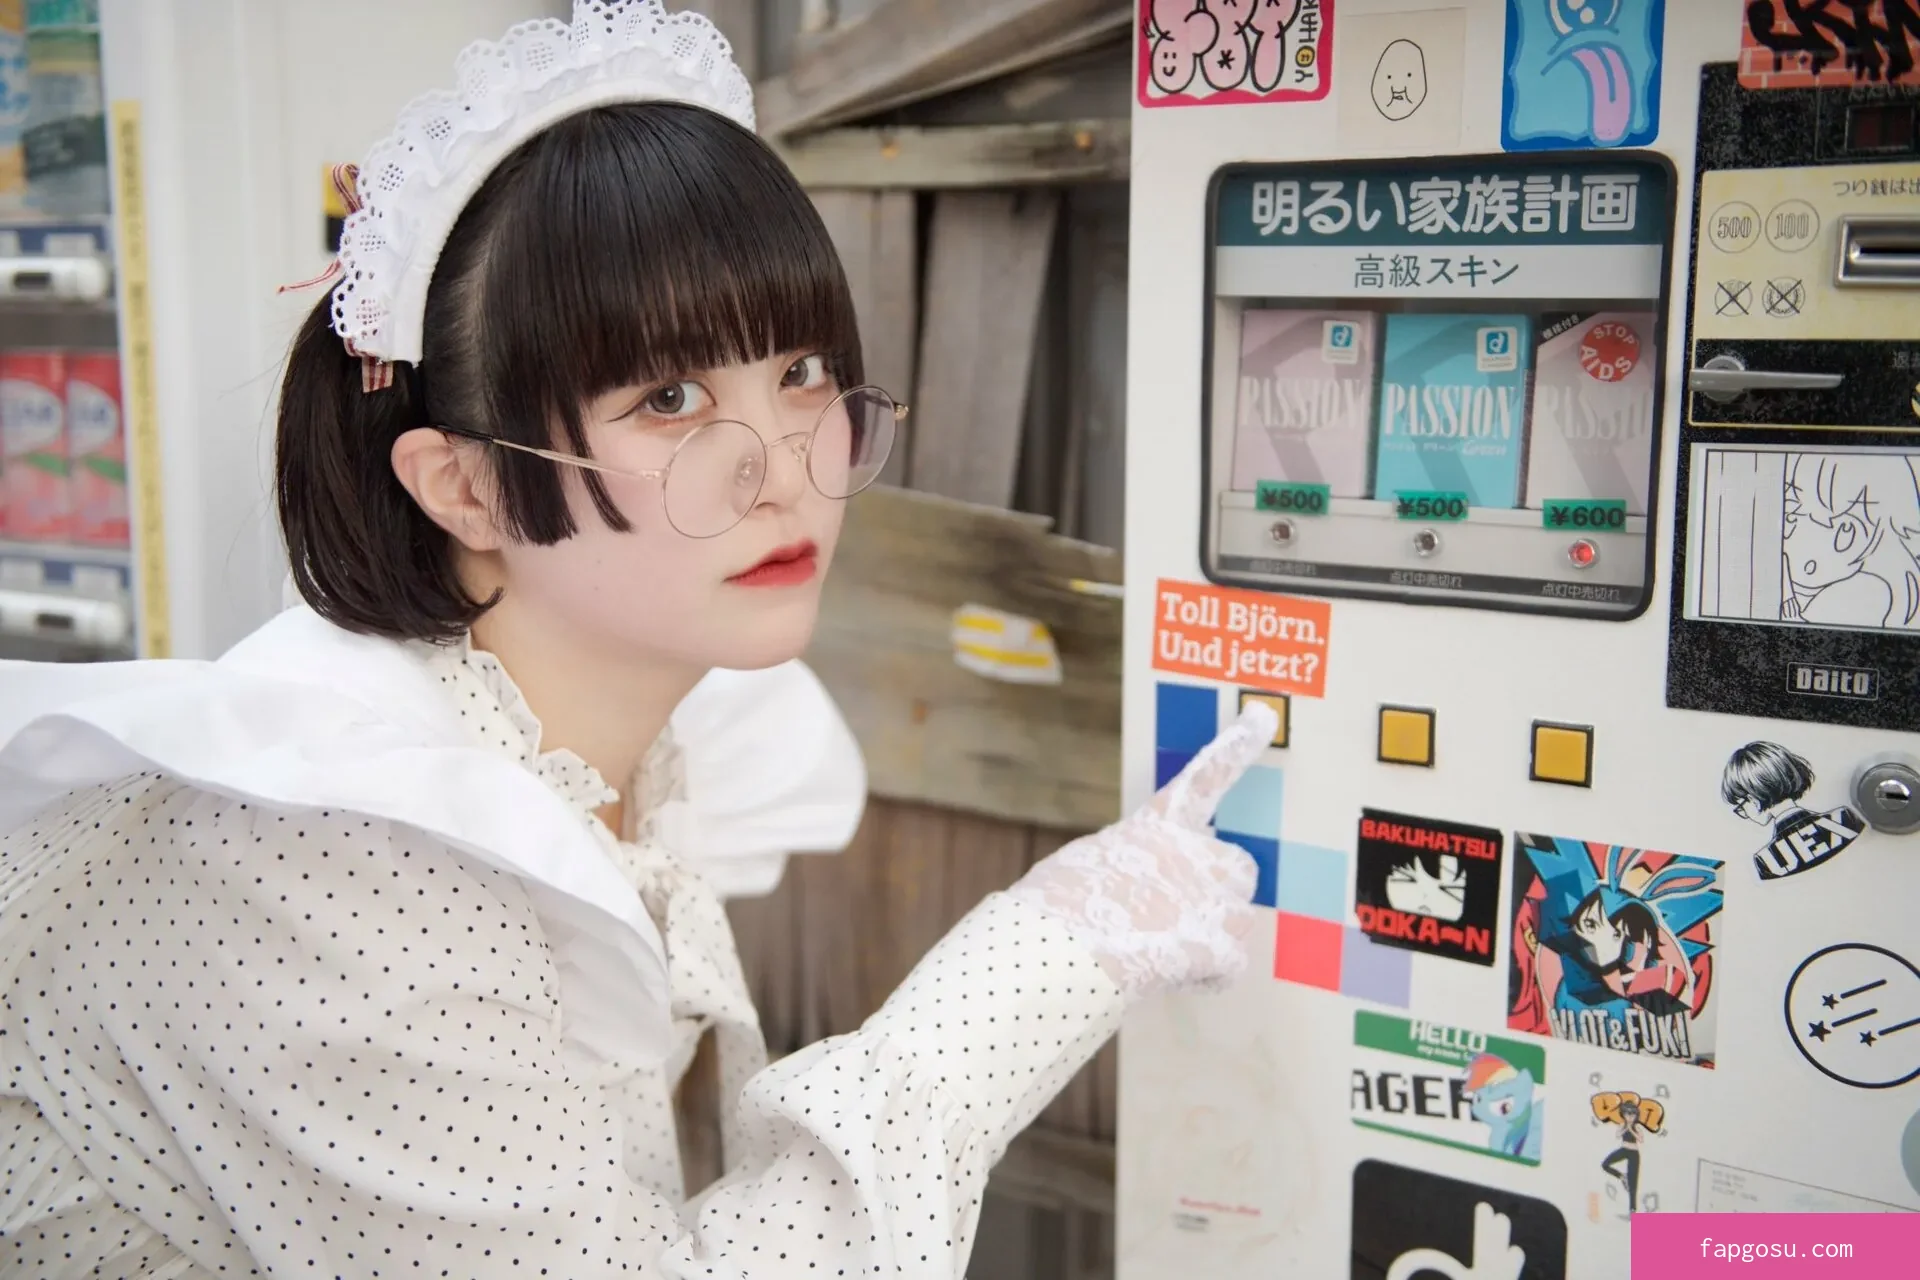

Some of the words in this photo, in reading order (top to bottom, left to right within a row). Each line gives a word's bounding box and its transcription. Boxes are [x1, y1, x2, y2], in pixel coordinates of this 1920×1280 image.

[1252, 174, 1640, 236] 明るい家族計画
[1717, 215, 1752, 239] 500
[1773, 212, 1810, 240] 100
[1353, 253, 1519, 288] 高級スキン
[1593, 323, 1635, 345] STOP
[1582, 345, 1632, 380] AIDS
[1240, 375, 1365, 429] PASSION
[1384, 382, 1518, 440] PASSION
[1538, 383, 1655, 442] PASSIO
[1262, 487, 1323, 512] ¥500
[1396, 496, 1464, 518] ¥500
[1551, 505, 1626, 528] ¥600
[1542, 583, 1620, 601] 点灯中売切れ
[1161, 591, 1220, 628] Toll
[1226, 601, 1325, 646] Björn.
[1159, 629, 1222, 668] Und
[1224, 639, 1319, 683] jetzt?
[1360, 818, 1497, 861] BAKUHATSU
[1409, 1018, 1487, 1053] HELLO
